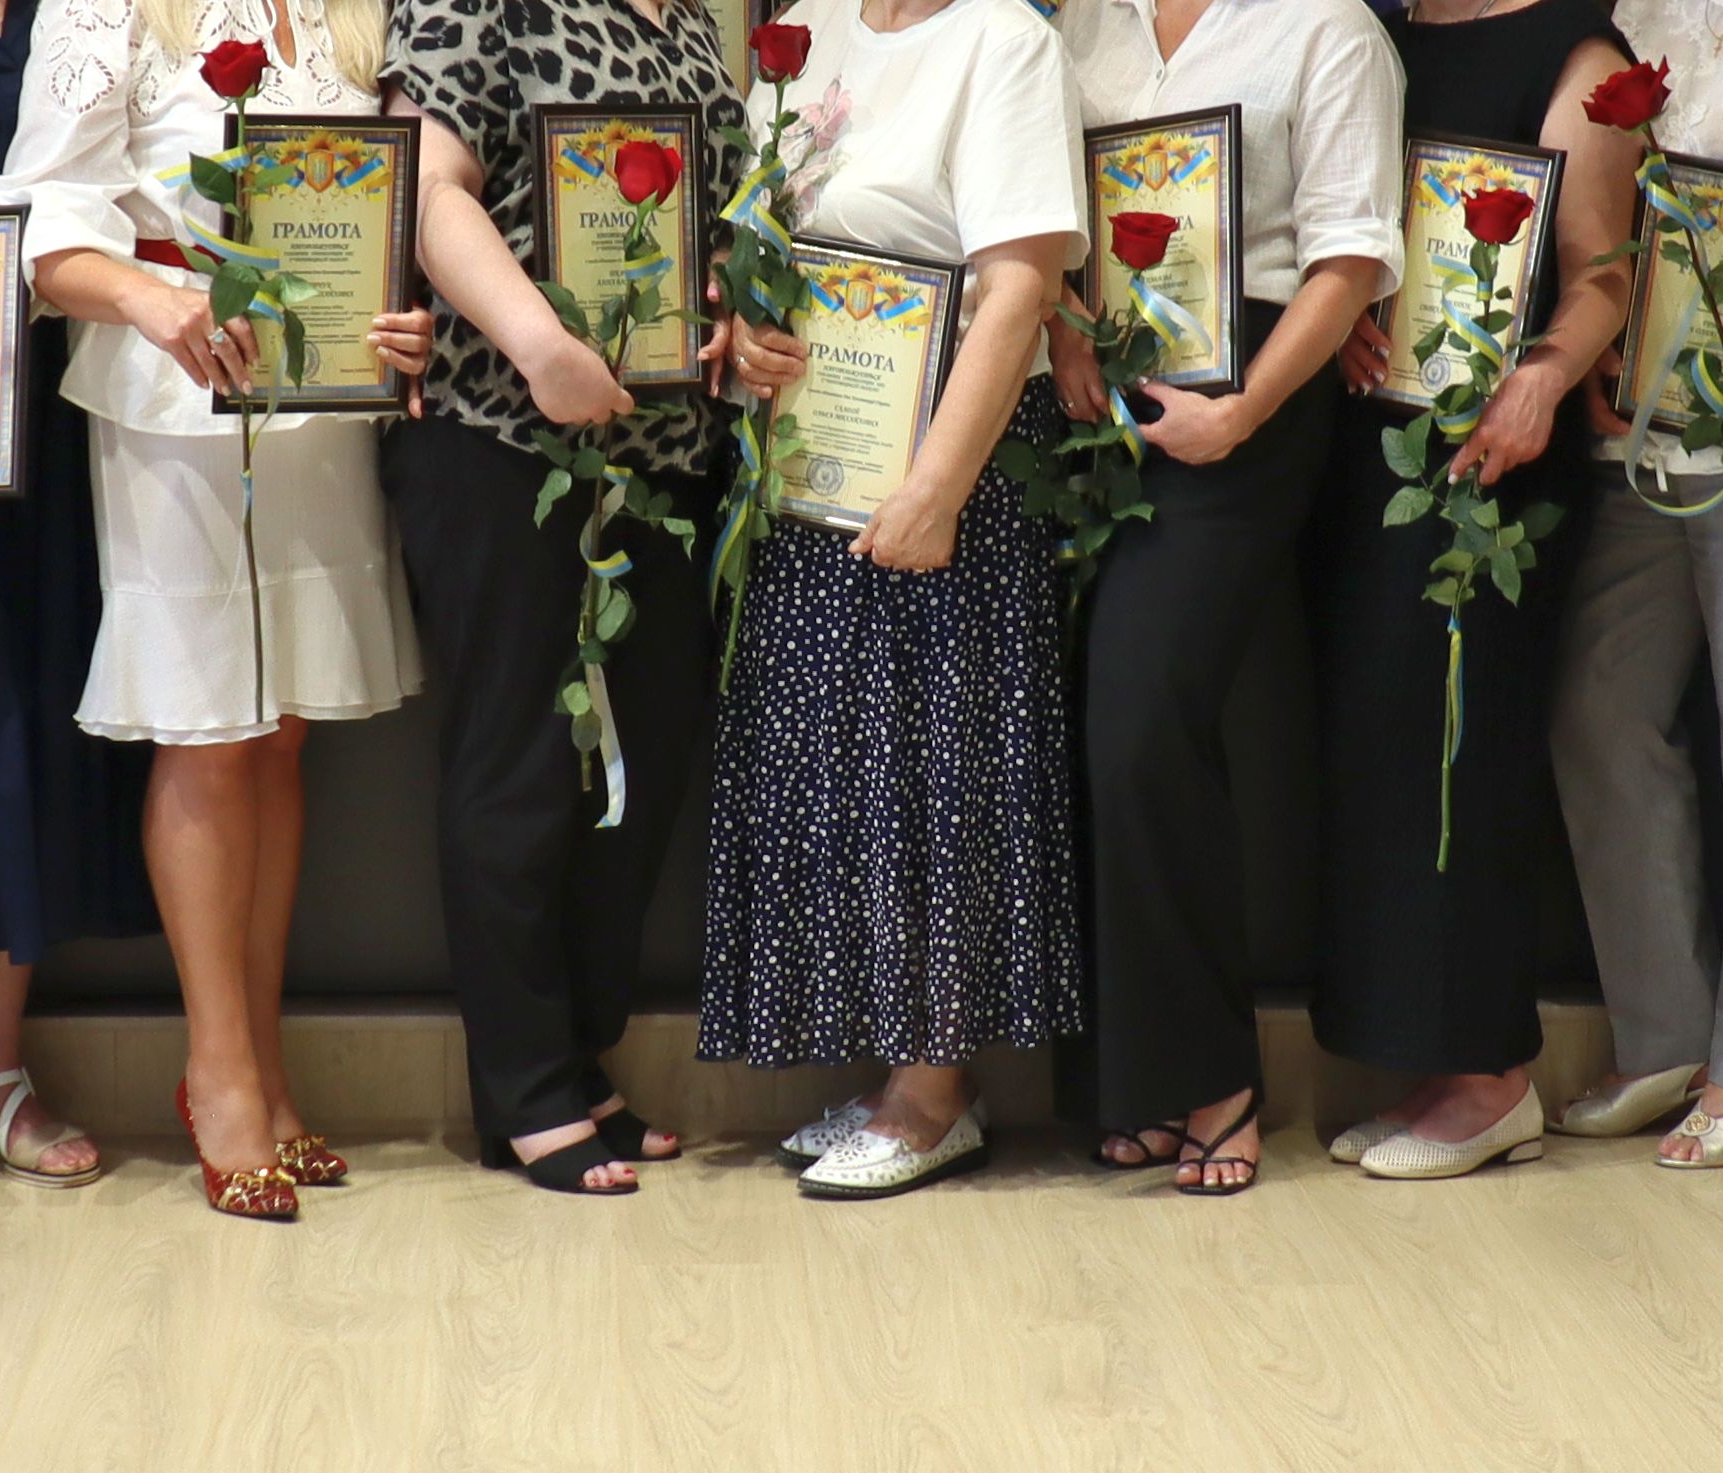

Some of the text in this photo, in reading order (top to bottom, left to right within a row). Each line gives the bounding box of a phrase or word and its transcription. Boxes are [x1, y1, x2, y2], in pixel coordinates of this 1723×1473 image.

[579, 211, 658, 228] ГРАМОА
[272, 222, 363, 240] ГРАМОТА
[1426, 237, 1469, 259] ГРАМ
[808, 342, 895, 374] ГРАМОТА
